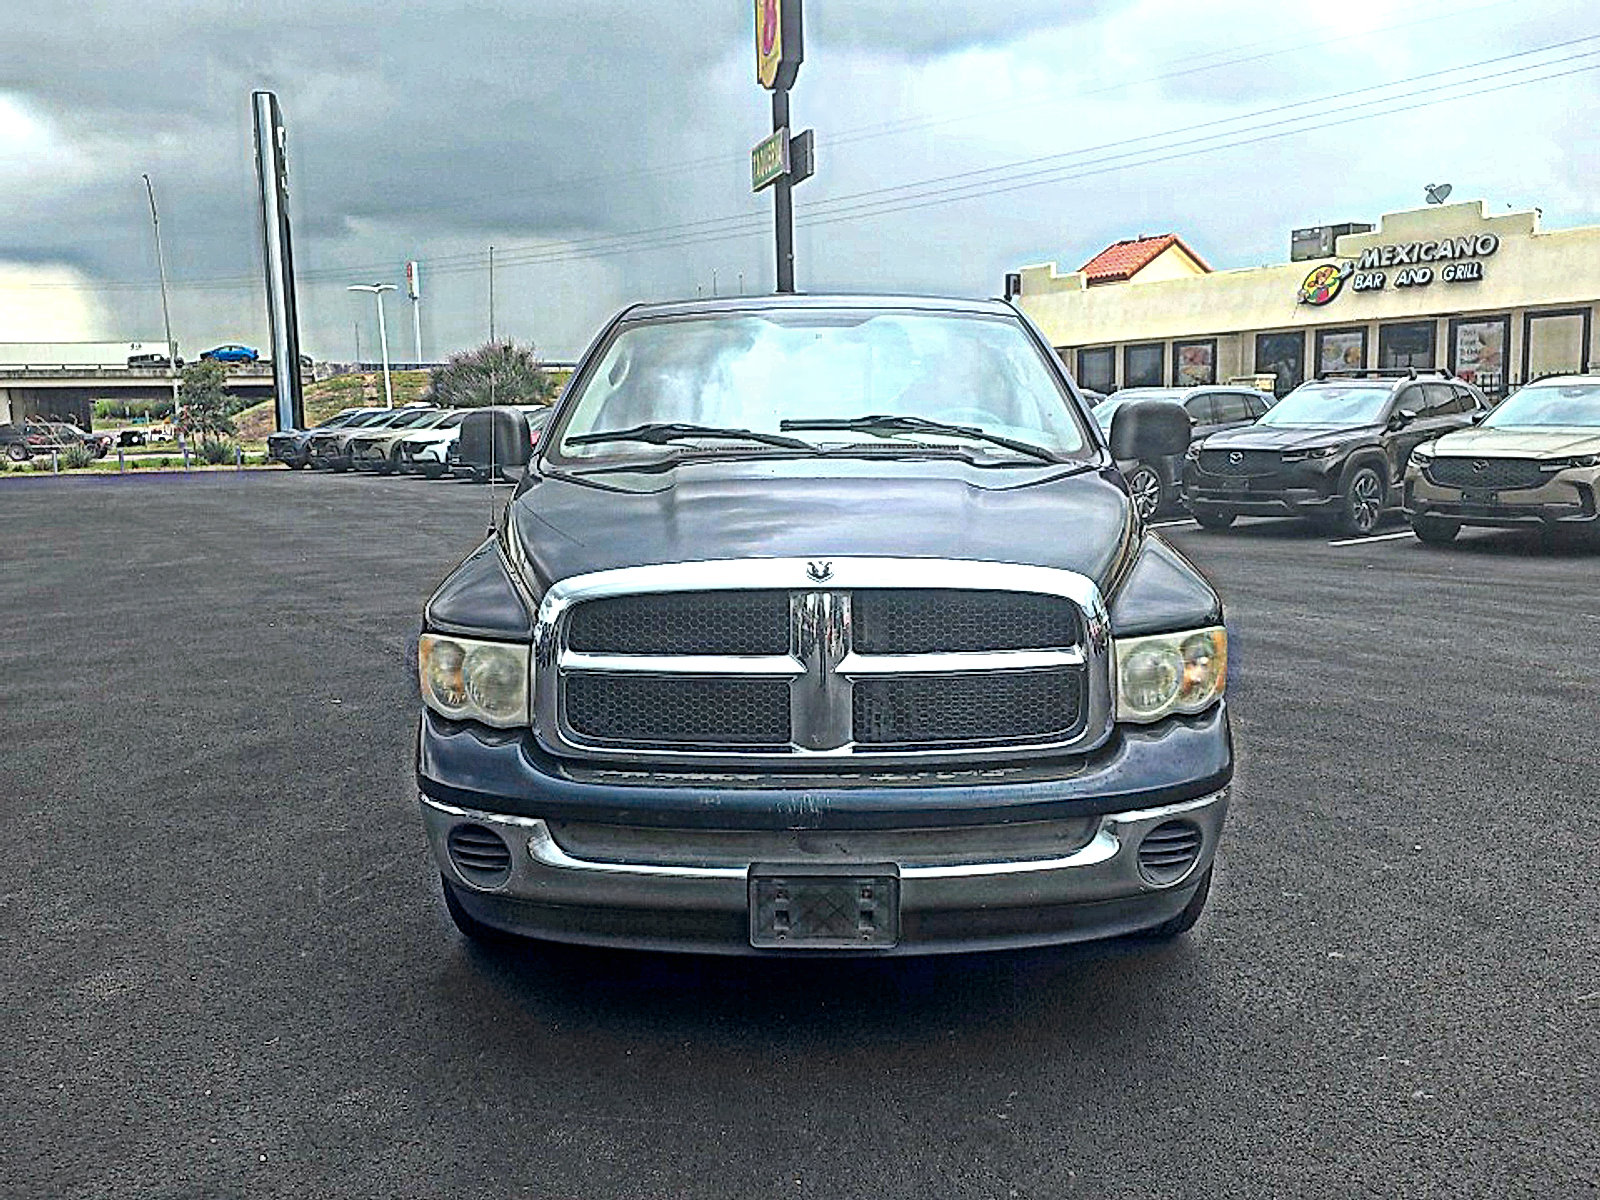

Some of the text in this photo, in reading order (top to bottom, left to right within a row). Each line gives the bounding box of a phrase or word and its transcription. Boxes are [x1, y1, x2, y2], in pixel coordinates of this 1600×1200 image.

[1358, 234, 1498, 268] MEXICANO
[1354, 262, 1481, 290] BAR AND GRILL
